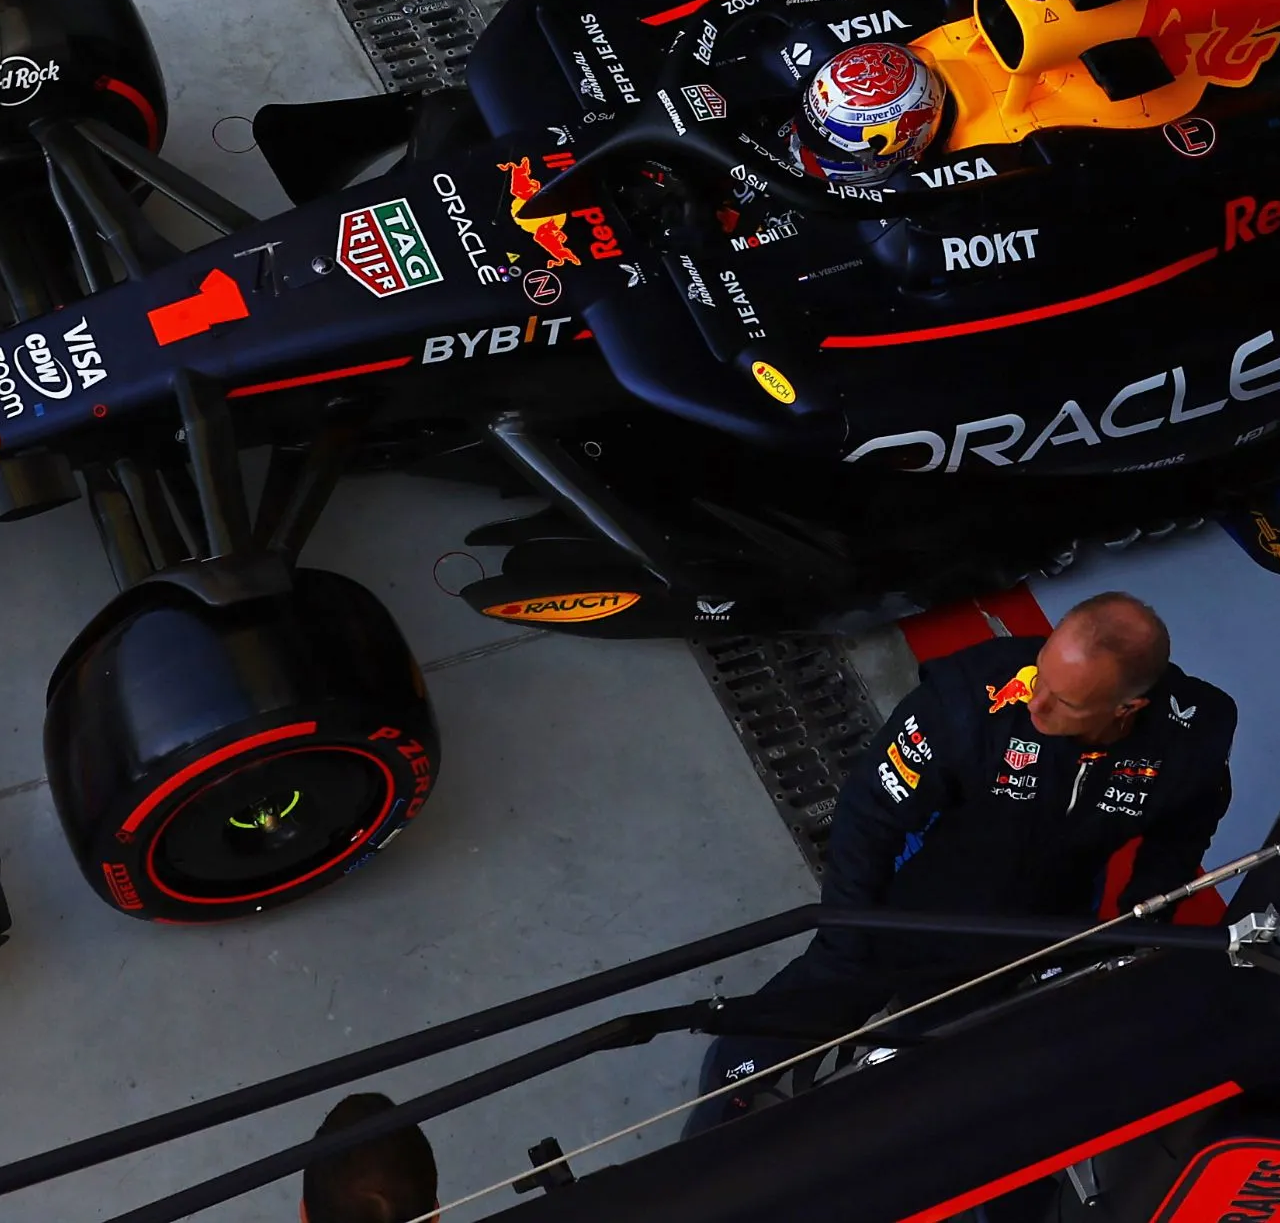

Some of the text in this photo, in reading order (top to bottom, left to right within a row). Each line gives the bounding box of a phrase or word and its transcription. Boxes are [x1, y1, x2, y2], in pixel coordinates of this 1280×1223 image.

[692, 19, 718, 66] telcel
[827, 9, 913, 43] VISA
[15, 60, 60, 87] Rock
[580, 13, 641, 104] PEPE JEANS
[686, 87, 708, 118] TAG
[700, 85, 725, 118] HEUER
[855, 110, 889, 122] Player
[738, 132, 804, 178] ORACLE
[911, 156, 998, 189] VISA
[745, 173, 769, 192] Sui
[827, 181, 883, 203] BYBIT
[382, 204, 431, 280] TAG
[432, 173, 501, 286] ORACLE
[571, 206, 623, 260] Red
[730, 228, 781, 252] Mobil
[942, 228, 1040, 272] ROKT
[347, 213, 397, 292] HEUER
[819, 258, 864, 278] VERSTAPPEN
[147, 268, 251, 346] 1
[719, 269, 761, 325] JEANS
[24, 332, 62, 384] CDW
[63, 316, 108, 390] VISA
[421, 314, 572, 365] BYBIT
[762, 370, 791, 400] RAUCH
[522, 593, 621, 615] RAUCH
[897, 731, 923, 763] Claro
[904, 714, 933, 761] Mobil
[1008, 740, 1038, 754] TAG
[368, 726, 433, 819] P ZERO
